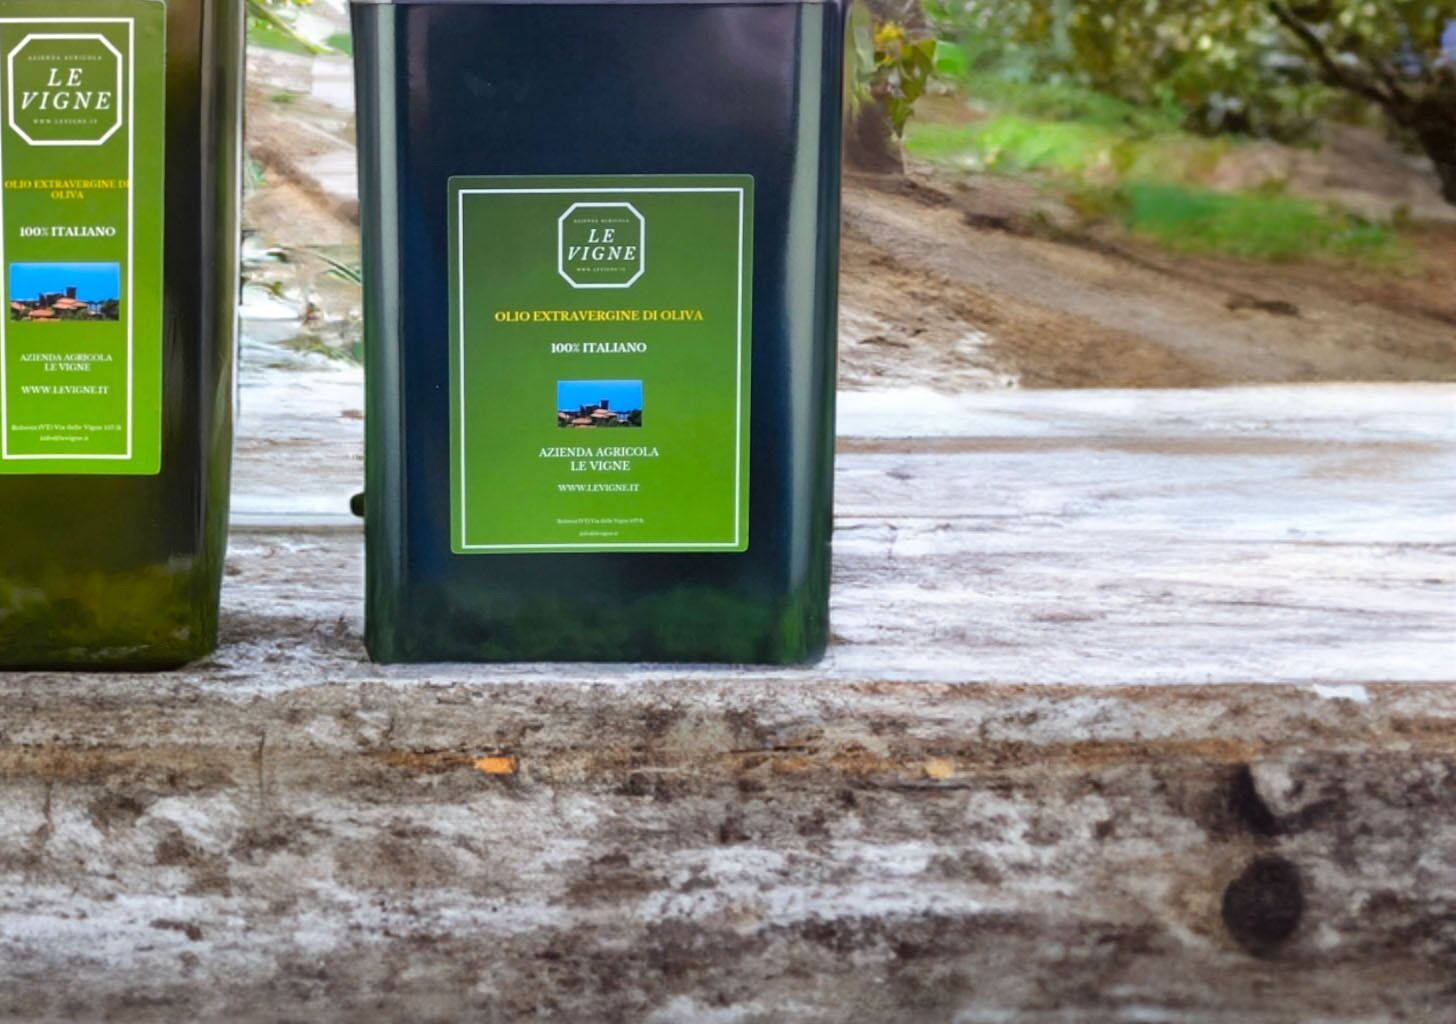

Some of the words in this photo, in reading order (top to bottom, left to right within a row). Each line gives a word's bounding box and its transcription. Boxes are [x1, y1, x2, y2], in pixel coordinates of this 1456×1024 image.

[47, 67, 83, 87] LE
[21, 91, 112, 110] VIGNE
[4, 179, 32, 189] OLIO
[34, 179, 114, 189] EXTRAVERGINE
[50, 189, 85, 200] OLIVA
[20, 226, 49, 237] 100%
[51, 226, 116, 237] ITALIANO
[587, 228, 615, 244] LE
[567, 245, 637, 261] VIGNE
[494, 310, 531, 322] OLIO
[533, 309, 640, 322] EXTRAVERGINE
[642, 309, 657, 322] DI
[660, 309, 704, 322] OLIVA
[551, 342, 580, 354] 100%
[582, 342, 648, 354] ITALIANO
[20, 353, 62, 362] AZIENDA
[63, 353, 113, 362] AGRICOLA
[44, 362, 57, 372] LE
[58, 362, 91, 372] VIGNE
[538, 446, 594, 458] AZIENDA
[595, 446, 660, 457] AGRICOLA
[570, 460, 587, 472] LE
[589, 460, 631, 472] VIGNE
[557, 483, 640, 493] WWW.LEVIGNE.IT
